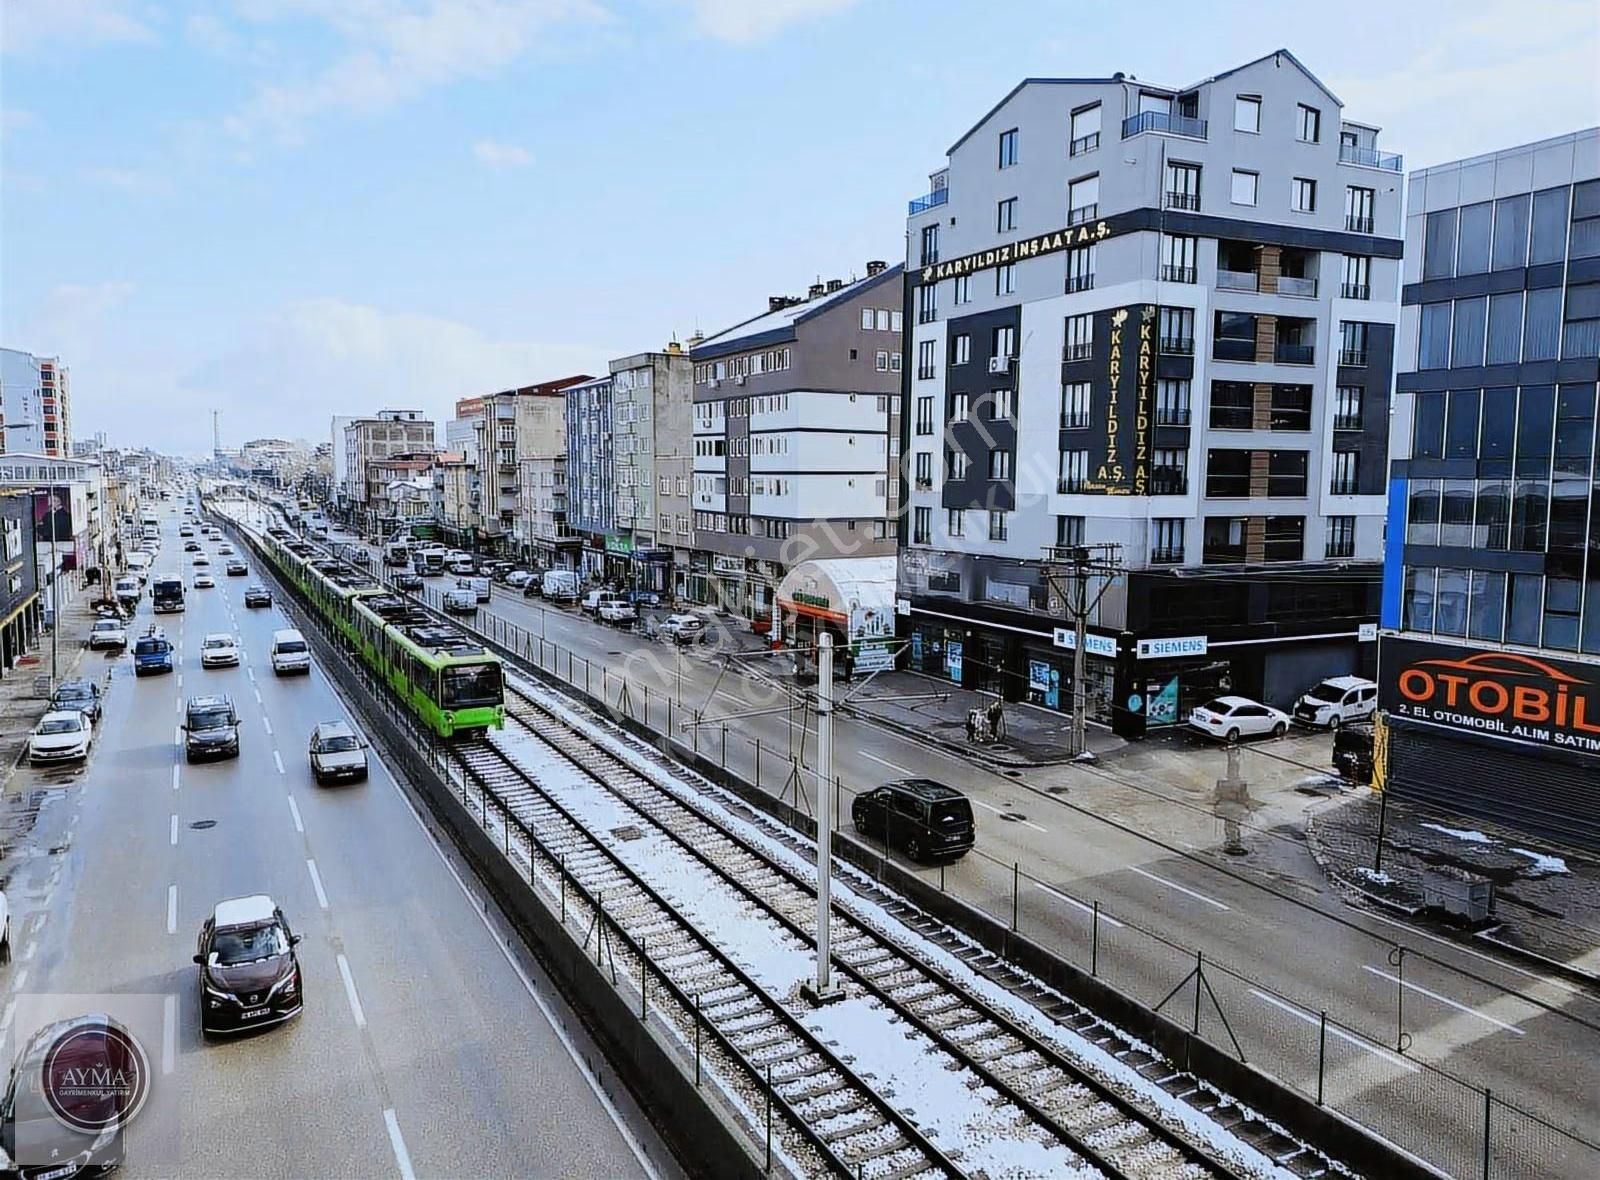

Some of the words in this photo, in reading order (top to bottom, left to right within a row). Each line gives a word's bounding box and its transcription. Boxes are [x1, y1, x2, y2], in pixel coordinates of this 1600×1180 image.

[936, 246, 1010, 279] KARYILDIZ
[1014, 229, 1074, 258] İNŞAAT
[1077, 221, 1111, 242] A.Ş.
[1107, 329, 1122, 463] KARYILDIZ
[1136, 324, 1151, 460] KARYILDIZ
[1097, 465, 1126, 484] A.Ş.
[1066, 633, 1114, 653] SMENS
[1153, 639, 1204, 654] SIEMENS
[1398, 669, 1600, 734] OTOBİL
[1399, 703, 1410, 714] 2.
[1413, 706, 1430, 718] EL
[1433, 710, 1509, 733] OTOMOBİL
[1511, 725, 1550, 741] ALIM
